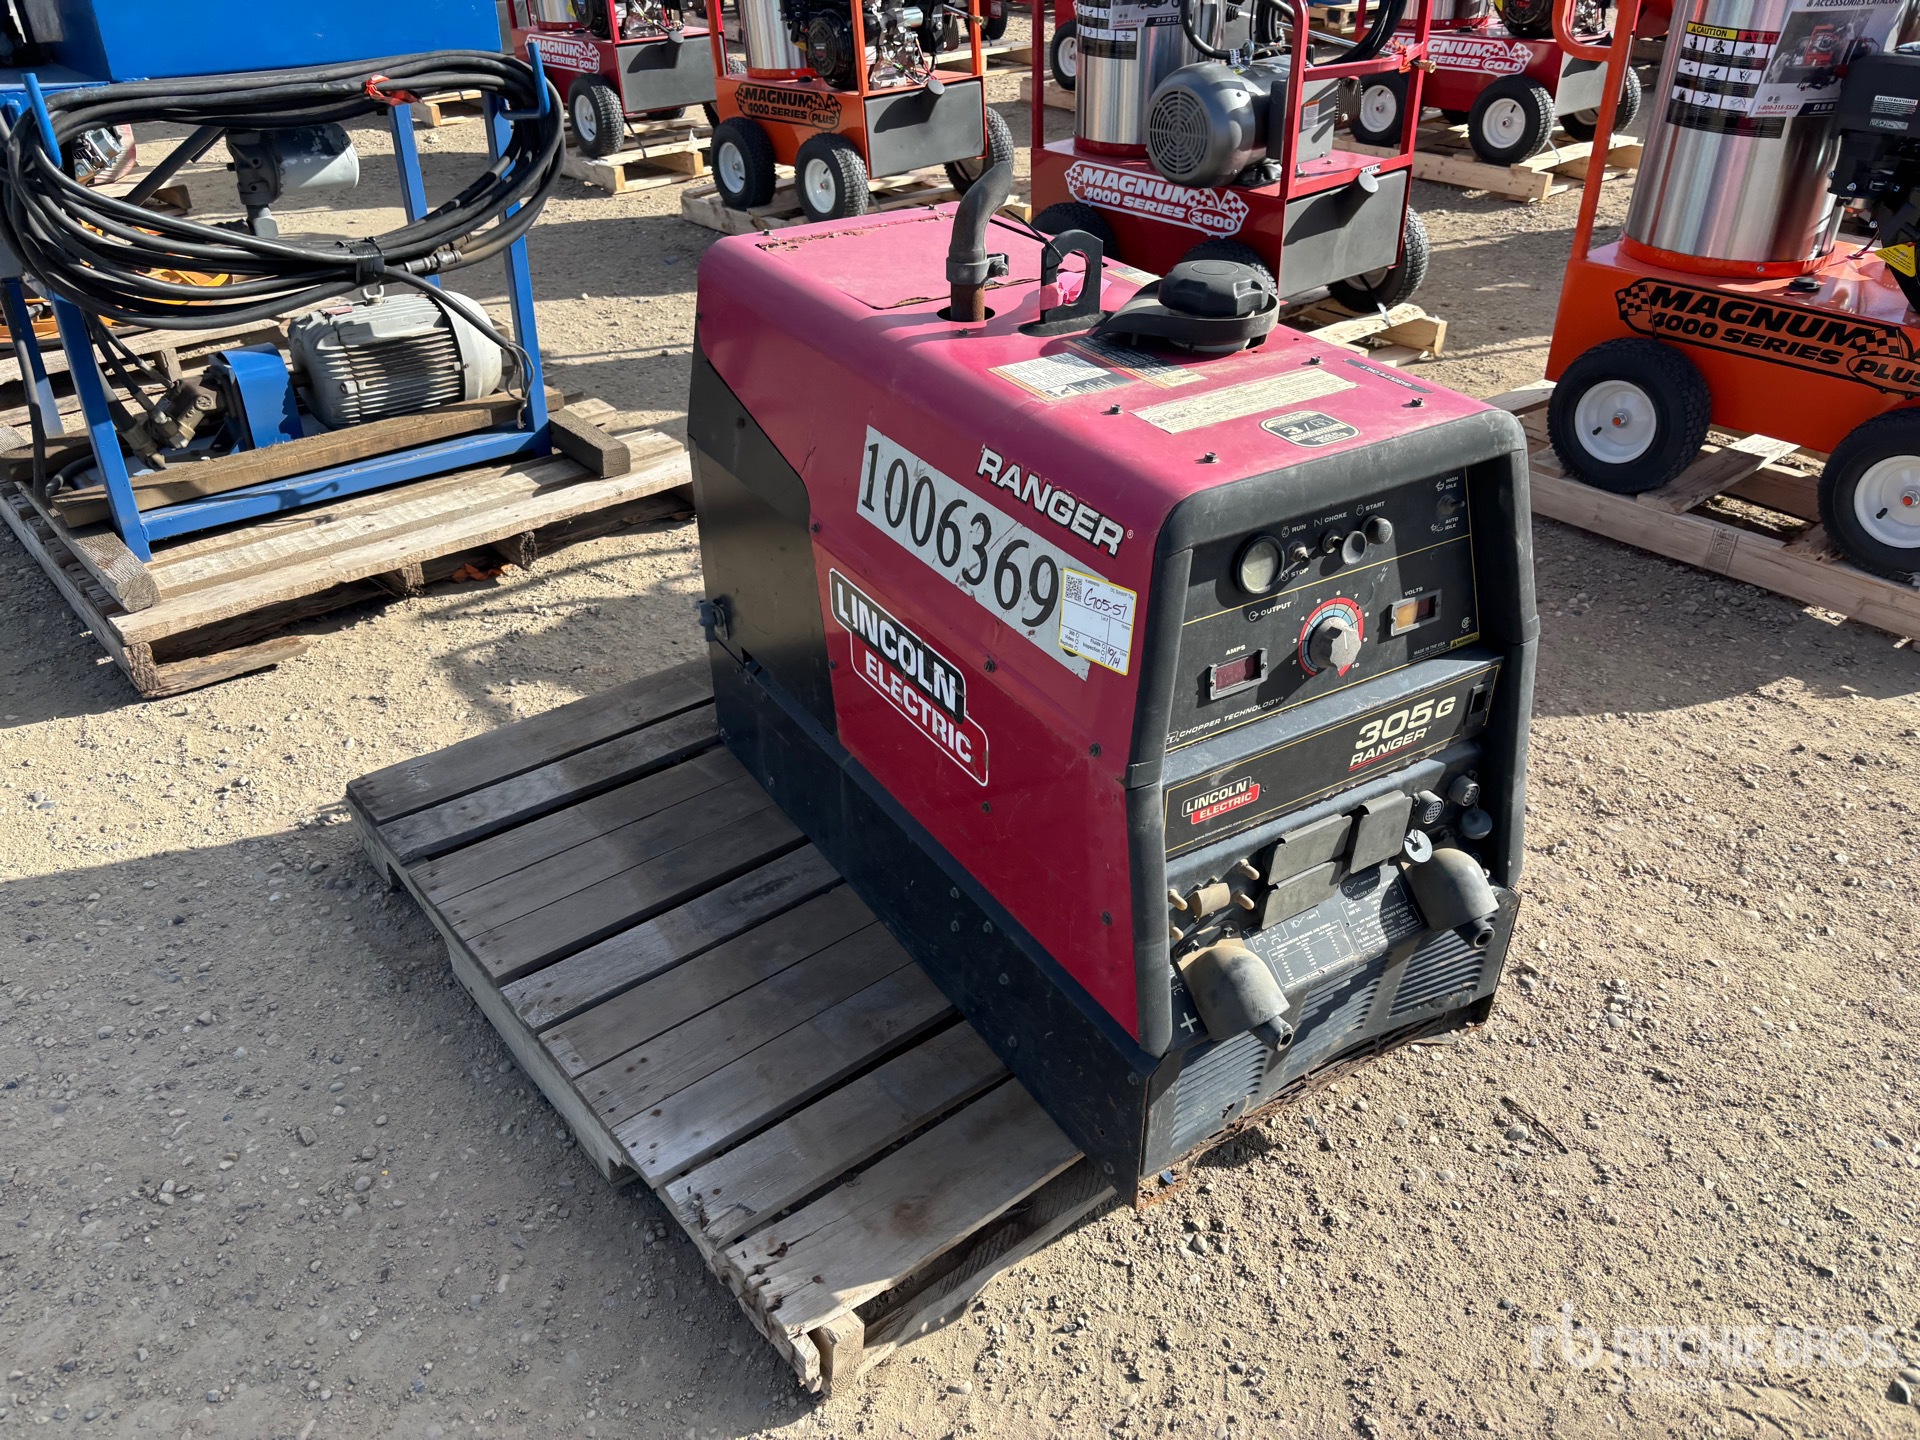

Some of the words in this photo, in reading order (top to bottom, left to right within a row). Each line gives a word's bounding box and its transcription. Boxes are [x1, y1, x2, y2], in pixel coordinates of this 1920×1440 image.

[1696, 27, 1728, 38] CAUTION
[1394, 38, 1488, 56] MGNUM
[551, 56, 577, 66] SERIES
[579, 60, 597, 70] GOLD
[1429, 55, 1481, 67] SERIES
[1484, 60, 1520, 72] GOLD
[745, 88, 812, 108] MAGNUM
[748, 103, 770, 115] 4000
[770, 106, 808, 120] SERIES
[811, 113, 836, 125] PLUS
[1082, 167, 1199, 206] MAGNUM
[1086, 186, 1121, 205] 4000
[1122, 195, 1187, 219] SERIES
[1191, 211, 1236, 231] 3600
[1650, 285, 1873, 349] MAGNUM
[1651, 311, 1718, 339] 4000
[1720, 328, 1845, 365] SERIES
[1445, 482, 1457, 490] IDLE
[1446, 476, 1459, 484] HIGH
[1365, 500, 1386, 511] START
[1324, 511, 1348, 523] CHOKE
[1445, 516, 1459, 524] AUTO
[1291, 524, 1307, 533] RUN
[1444, 523, 1457, 531] IDLE
[861, 443, 1079, 657] 1006369
[1290, 567, 1309, 578] STOP
[1404, 586, 1424, 597] VOLTS
[1260, 601, 1292, 616] OUTPUT
[837, 582, 957, 715] LINCOLN
[1082, 641, 1101, 653] Inspection
[1225, 644, 1246, 656] AMPS
[865, 650, 972, 763] ELECTRIC
[1179, 718, 1221, 738] CHOPPER
[1223, 698, 1280, 722] TECHNOLOGY
[1350, 727, 1428, 767] RANGER
[1186, 780, 1247, 814] LINCOLN
[1200, 792, 1252, 819] ELECTRIC
